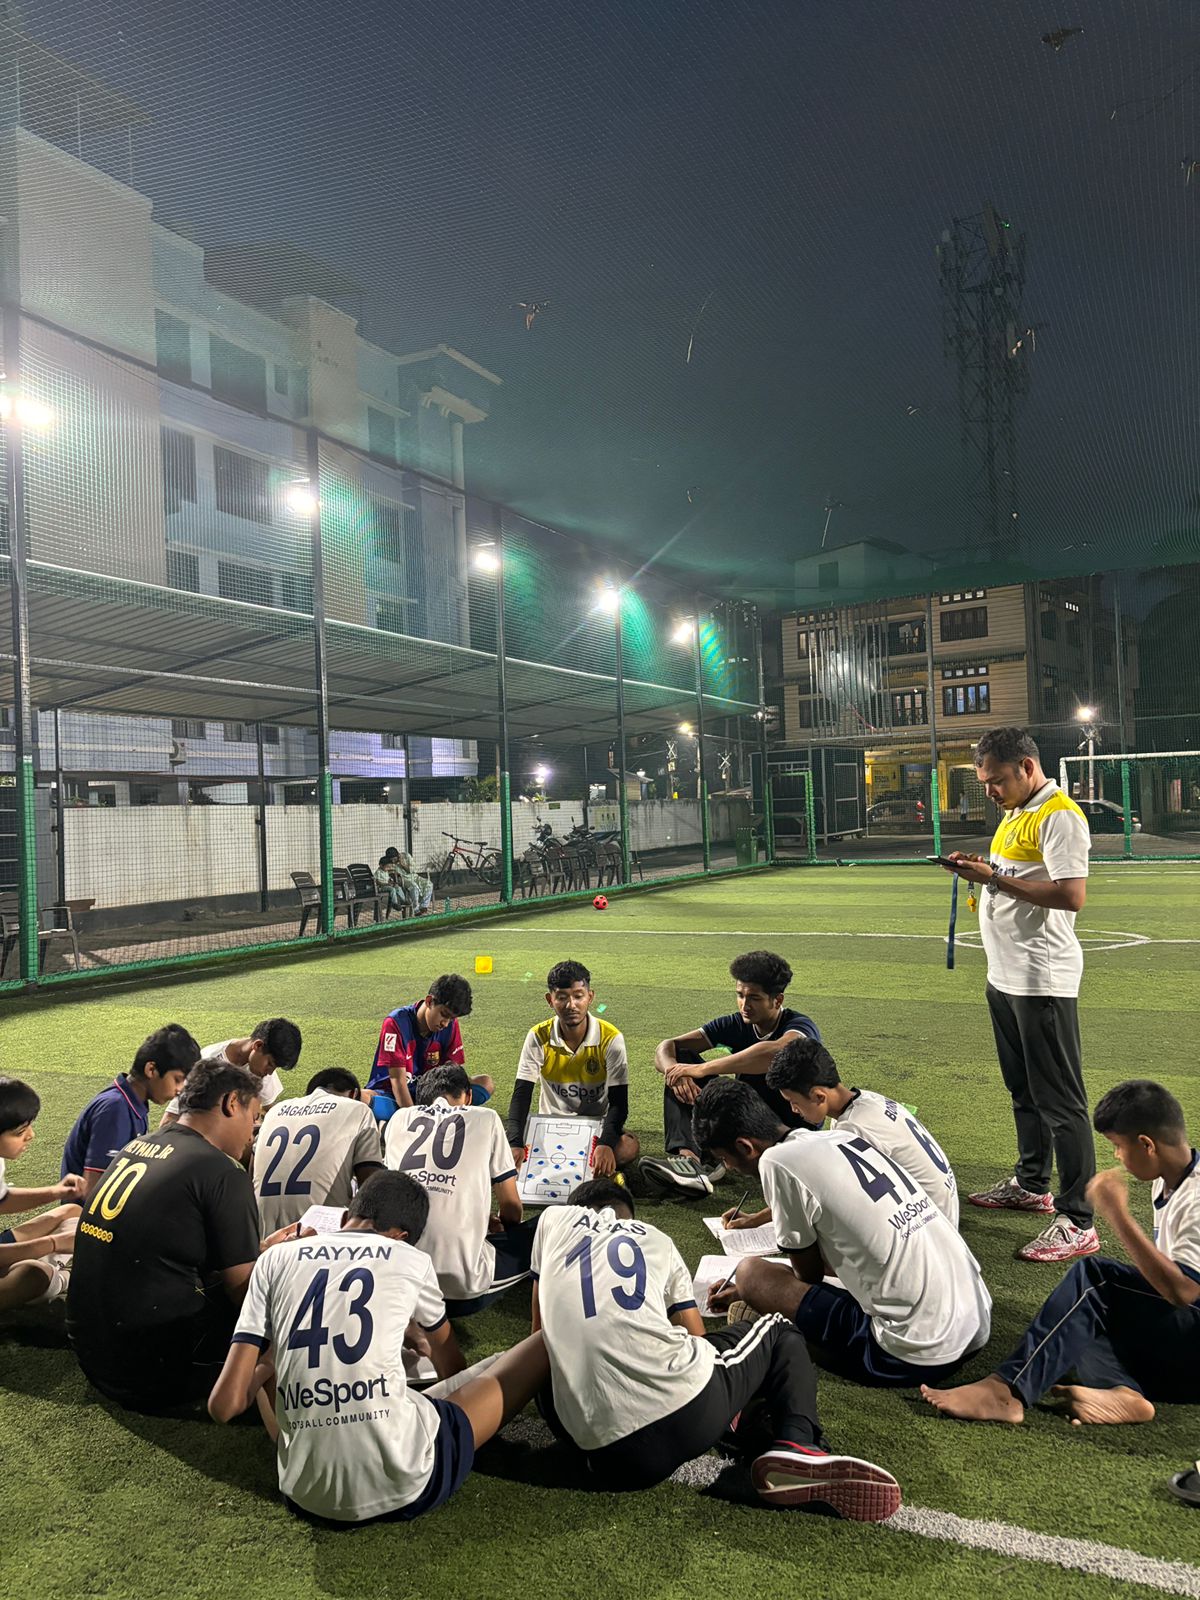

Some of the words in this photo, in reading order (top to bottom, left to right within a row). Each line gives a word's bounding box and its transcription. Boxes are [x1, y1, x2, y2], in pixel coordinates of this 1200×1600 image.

[278, 1103, 337, 1117] SAGARDEEP
[259, 1124, 321, 1197] 22
[400, 1113, 466, 1171] 20
[904, 1117, 949, 1175] 6
[88, 1157, 148, 1221] 10
[406, 1170, 457, 1187] eSport
[837, 1137, 918, 1206] 47
[887, 1197, 931, 1231] WeSpor
[297, 1246, 392, 1261] RAYYAN
[565, 1234, 647, 1320] 19
[287, 1267, 375, 1369] 43
[278, 1374, 389, 1412] WeSport
[325, 1409, 391, 1428] COMMUNITY
